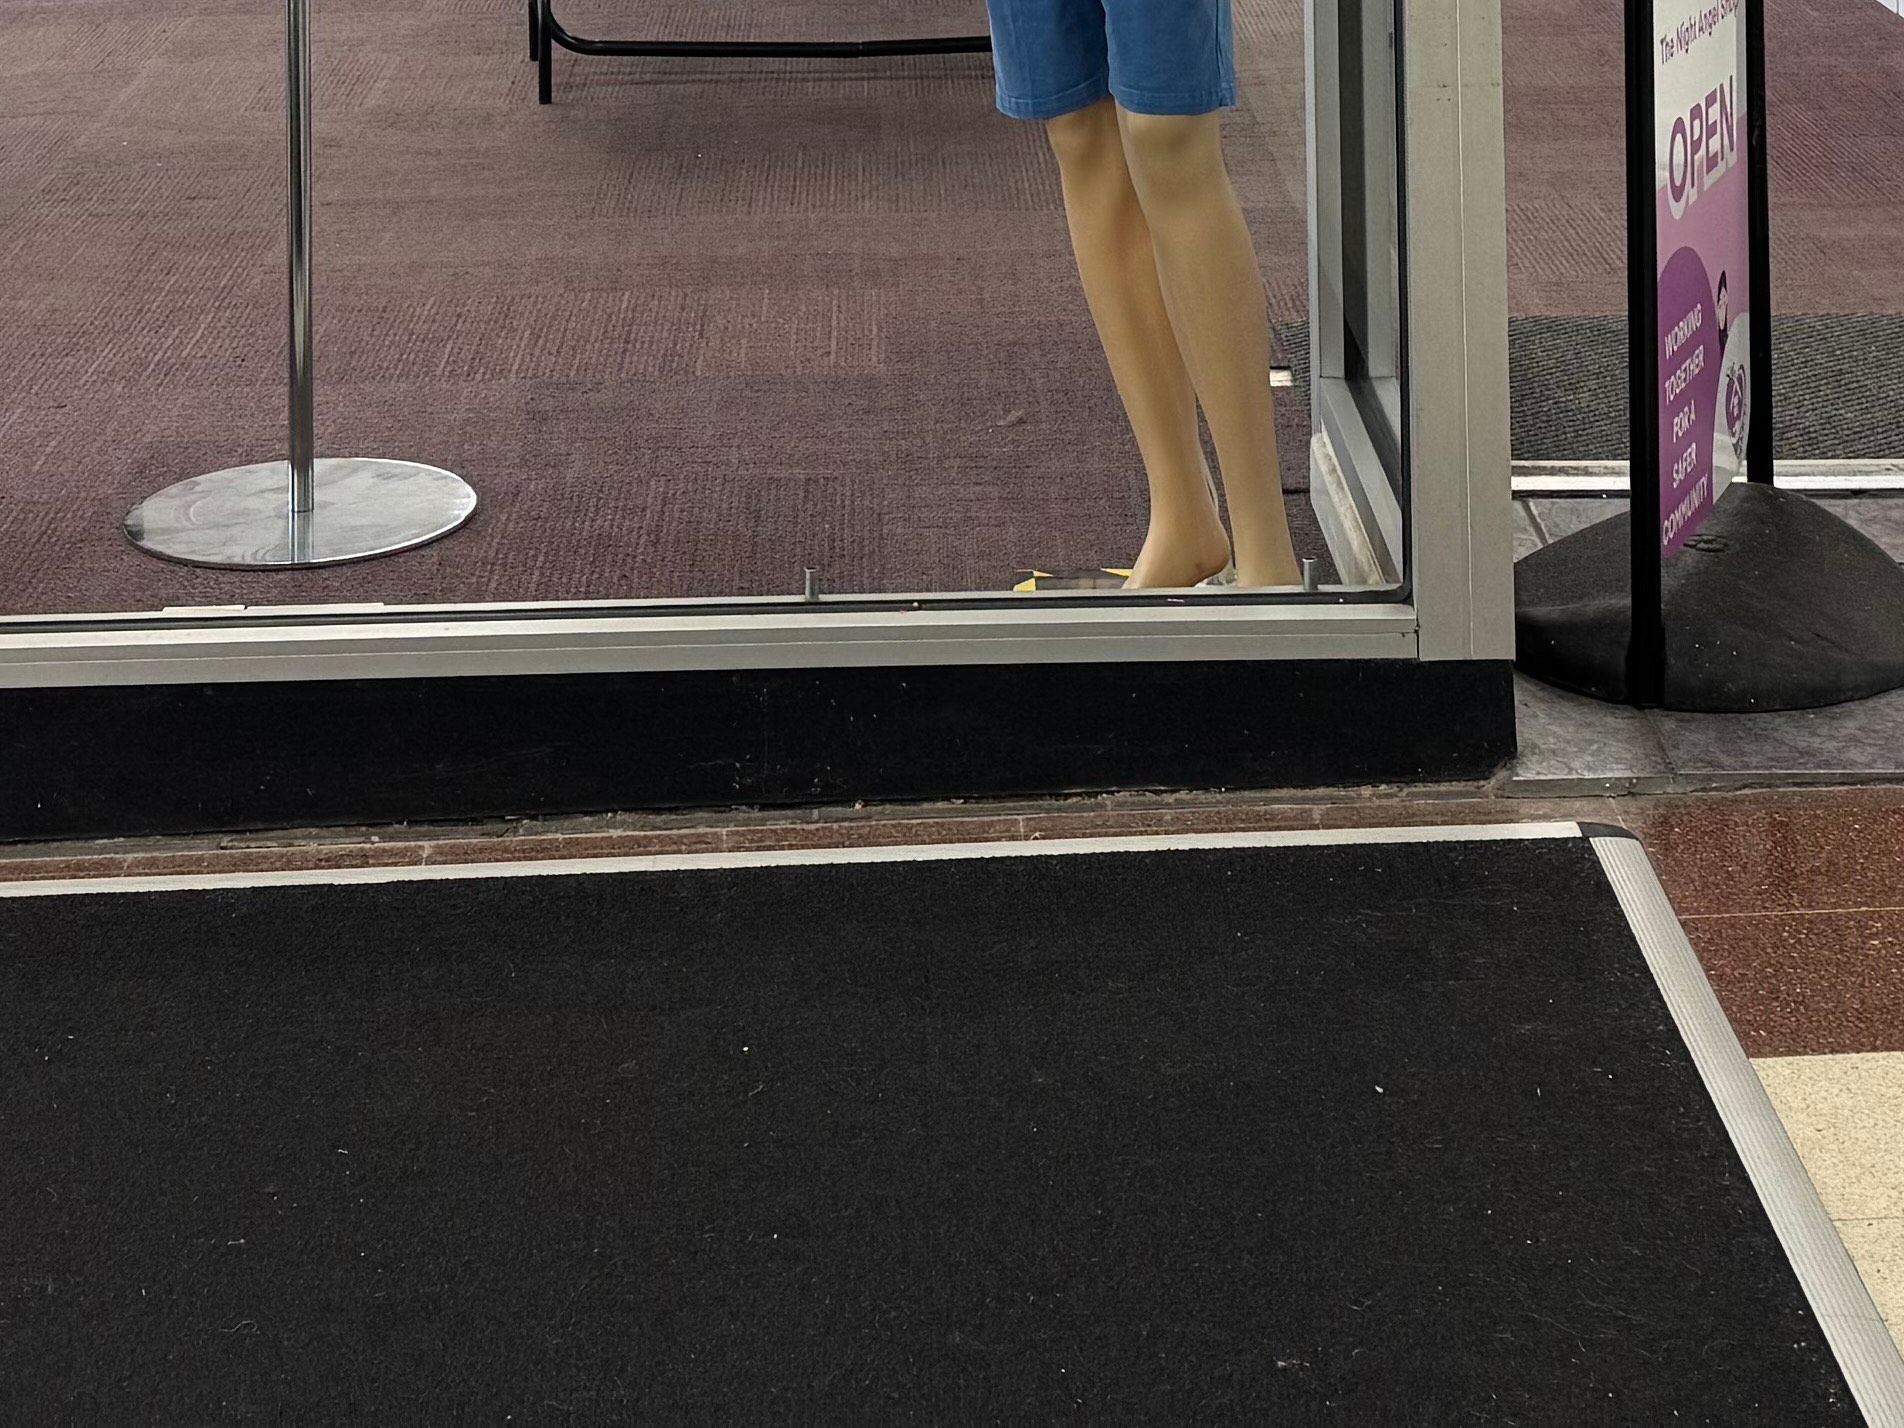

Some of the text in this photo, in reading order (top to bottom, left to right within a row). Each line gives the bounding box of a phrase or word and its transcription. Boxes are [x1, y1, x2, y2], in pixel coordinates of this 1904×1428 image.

[1660, 34, 1675, 65] The
[1676, 16, 1697, 54] Night
[1669, 75, 1735, 208] OPEN
[1665, 303, 1702, 359] WORKING
[1665, 345, 1704, 406] TOGETHER
[1672, 400, 1696, 443] FOR A
[1672, 442, 1697, 489] SAFER
[1662, 473, 1708, 546] COMMUNITY
